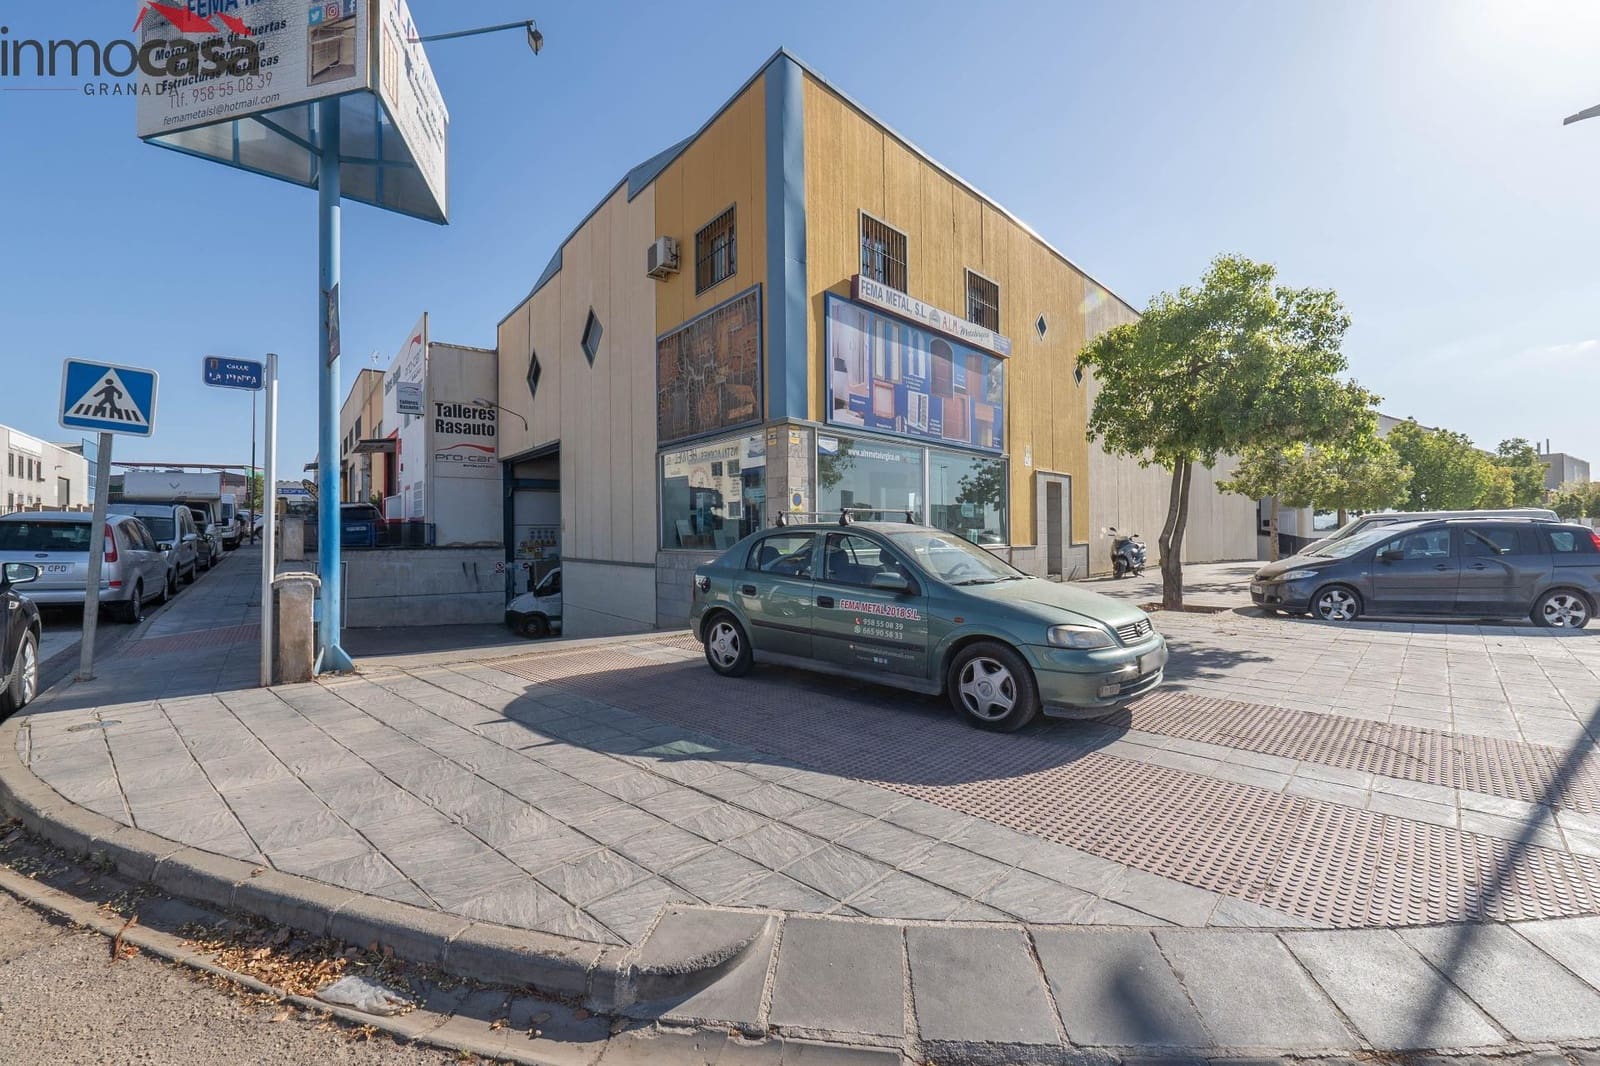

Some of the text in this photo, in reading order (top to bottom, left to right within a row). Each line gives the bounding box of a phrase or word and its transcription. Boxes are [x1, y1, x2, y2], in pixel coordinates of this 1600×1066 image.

[192, 84, 215, 103] 958
[219, 80, 234, 98] 55
[238, 77, 254, 93] 08
[258, 71, 273, 89] 39
[861, 279, 883, 301] FEMA
[435, 402, 496, 421] Talleres
[435, 418, 495, 437] Rasauto
[840, 599, 860, 611] FEMA
[861, 602, 887, 615] METAL
[863, 618, 875, 626] 958
[876, 620, 884, 628] 55
